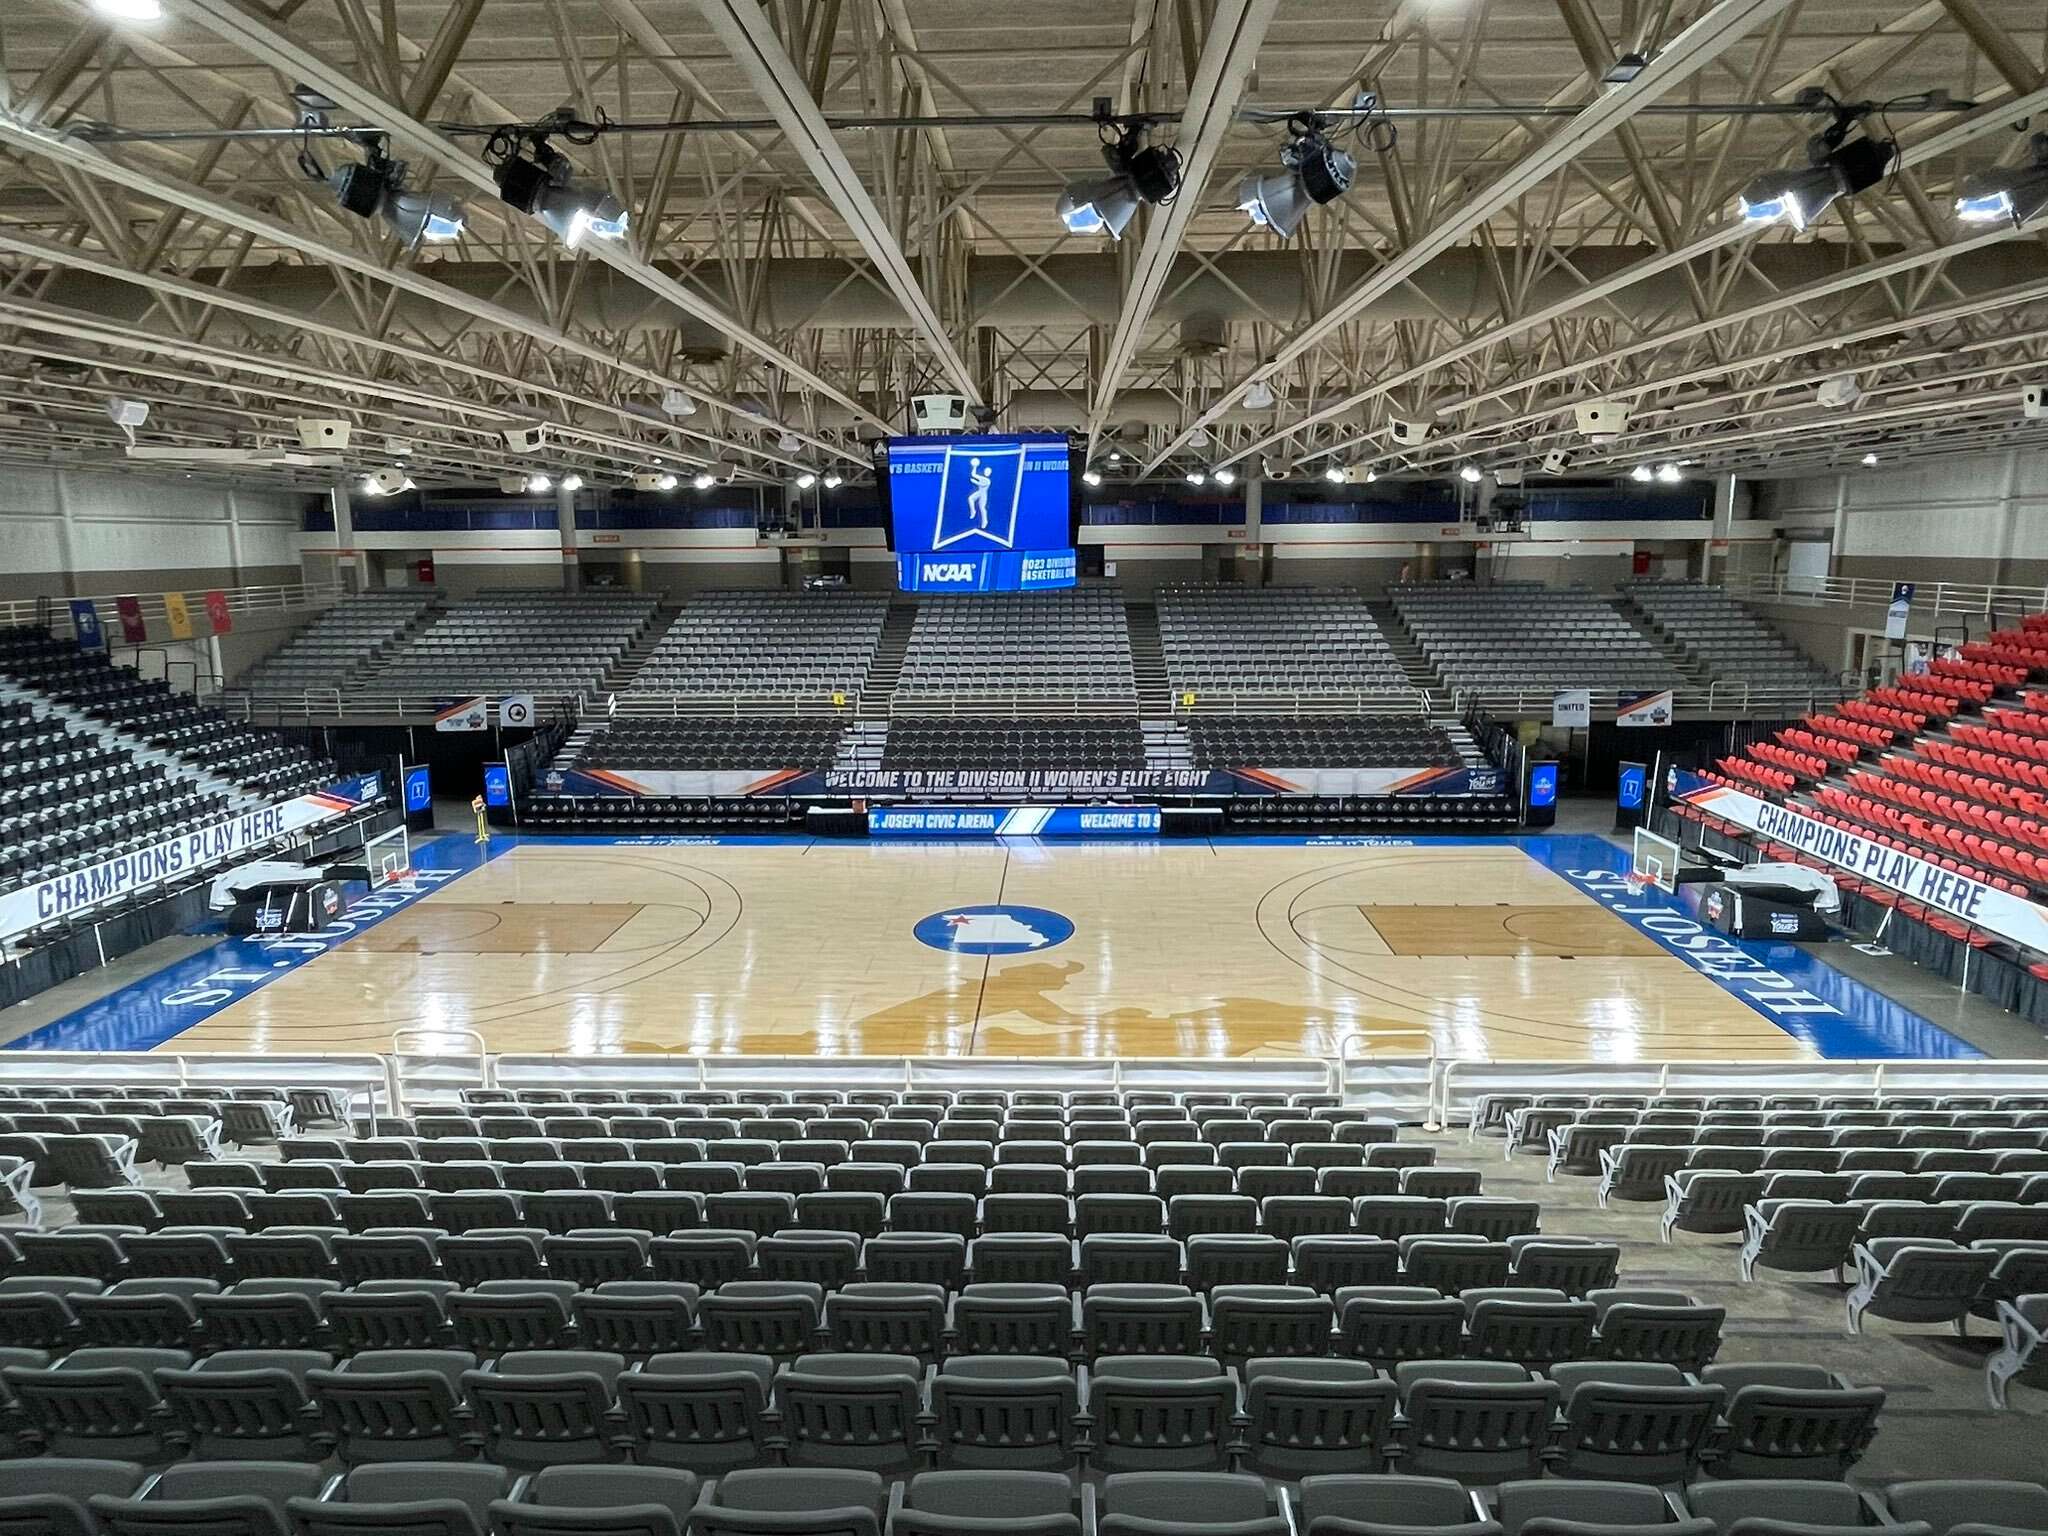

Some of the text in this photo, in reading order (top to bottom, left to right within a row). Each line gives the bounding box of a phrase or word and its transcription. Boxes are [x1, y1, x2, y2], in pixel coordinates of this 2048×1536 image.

[923, 563, 972, 582] NCAA
[825, 770, 1210, 787] WELCOME TO THE DIVISION II WOMEN'S ELITE EIGHT
[881, 814, 925, 829] JOSEPH
[926, 814, 957, 829] CIVIC
[957, 814, 995, 829] ARENA
[1080, 814, 1136, 828] WELCOME
[1137, 814, 1152, 828] TO
[37, 805, 285, 919] CHAMPIONS PLAY HERE
[1756, 803, 1988, 918] CHAMPIONS PLAY HERE
[1612, 904, 1844, 1016] JOSEPH
